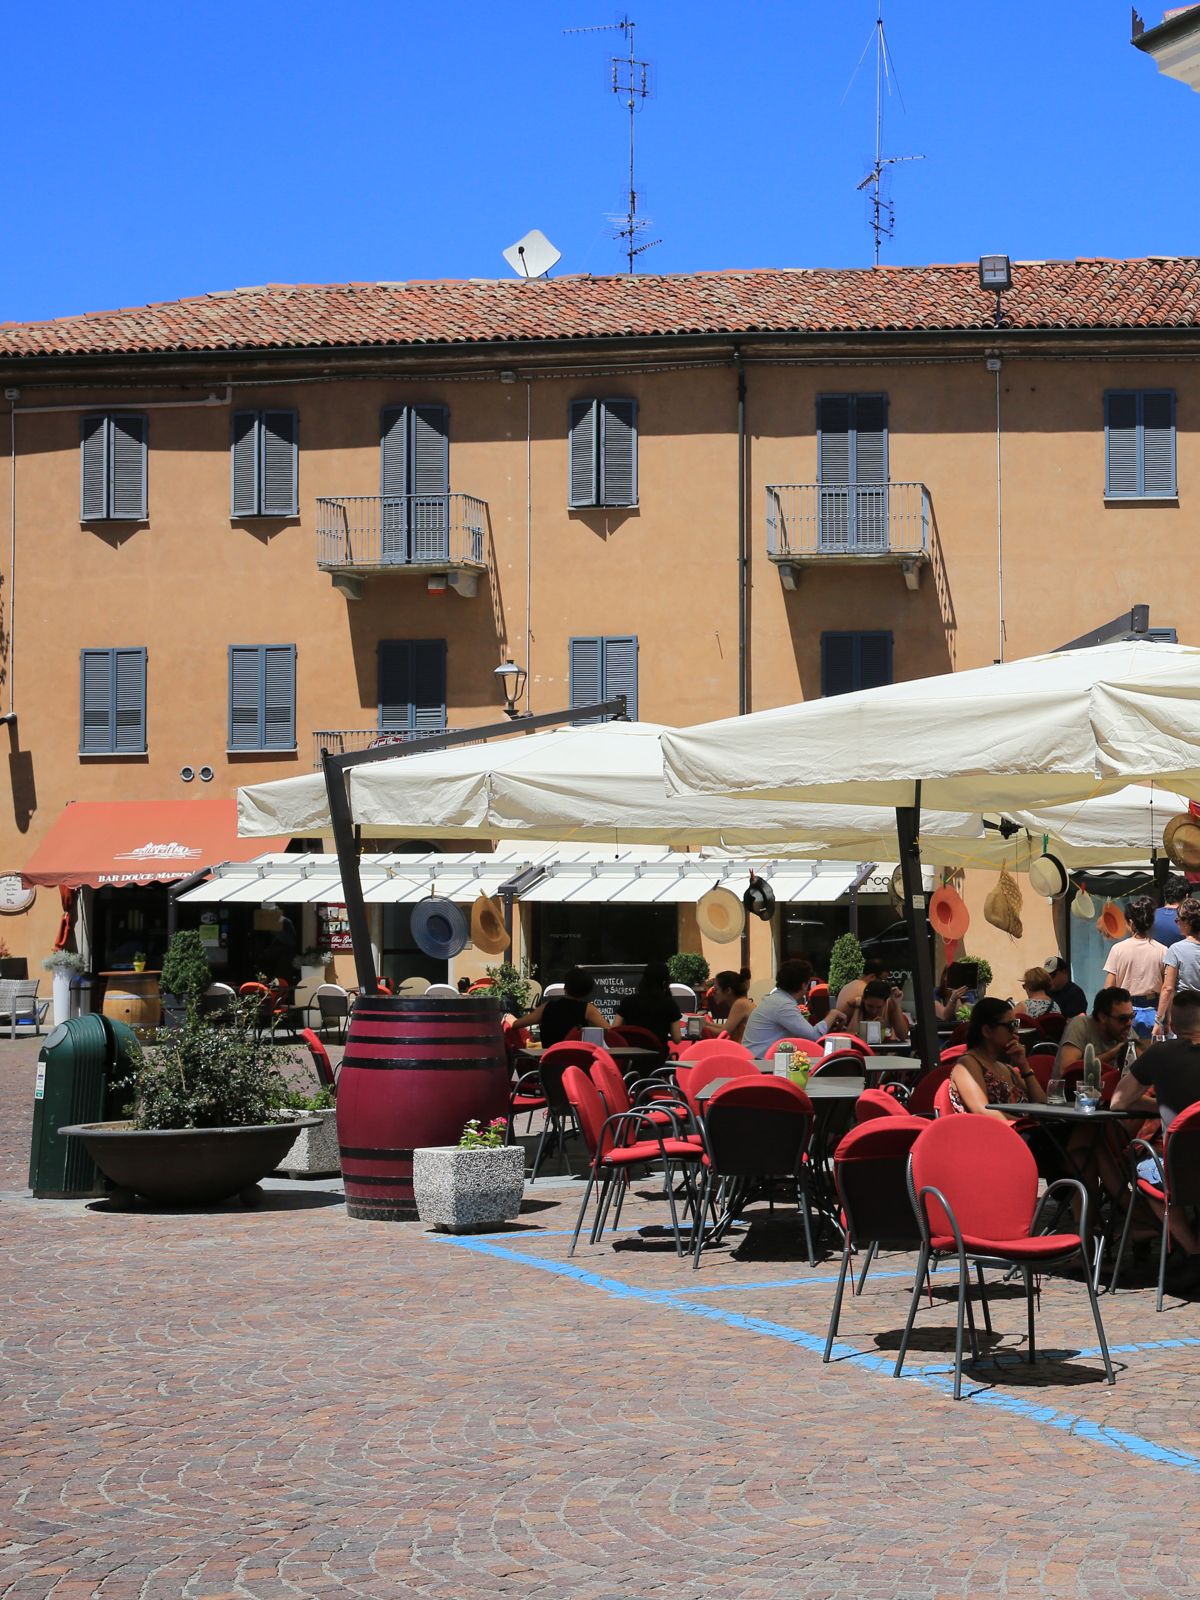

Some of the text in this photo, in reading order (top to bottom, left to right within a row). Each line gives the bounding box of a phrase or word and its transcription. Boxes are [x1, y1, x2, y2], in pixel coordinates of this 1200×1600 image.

[98, 874, 119, 883] BAR
[121, 872, 153, 881] DOUCE
[861, 877, 891, 886] rco
